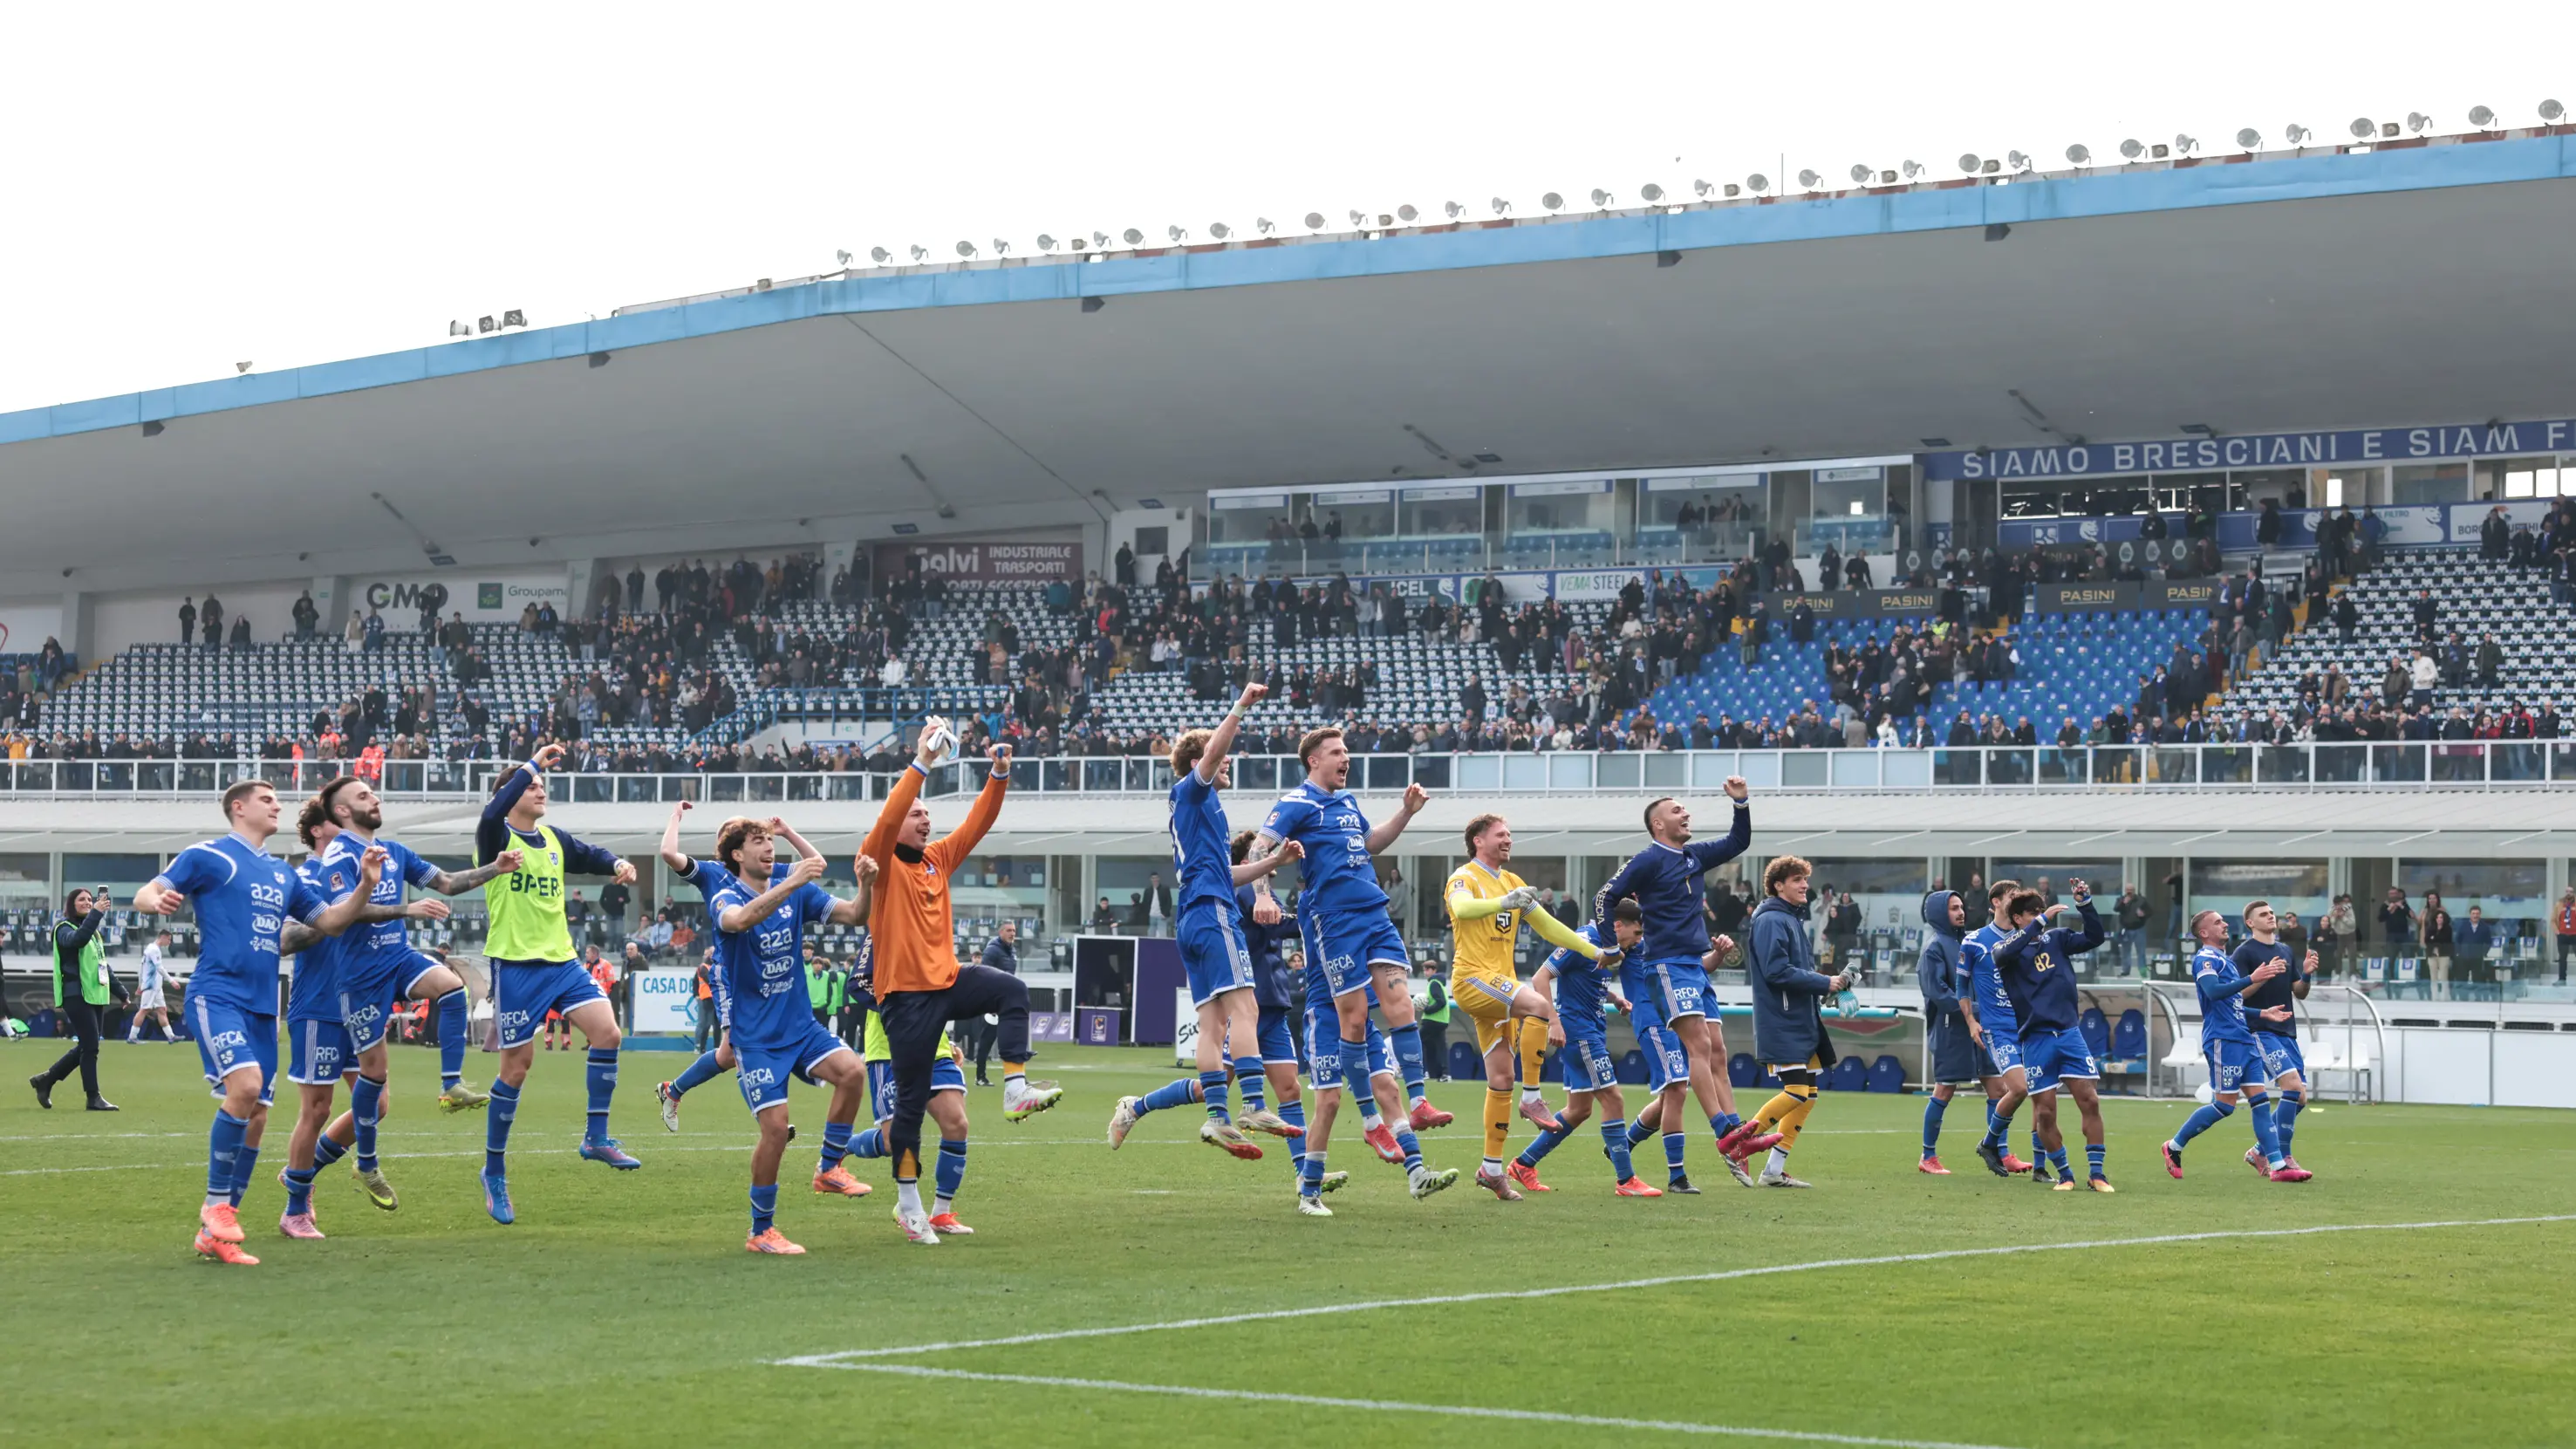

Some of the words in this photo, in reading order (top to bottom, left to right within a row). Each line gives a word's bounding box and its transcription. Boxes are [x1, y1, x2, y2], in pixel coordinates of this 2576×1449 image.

[1963, 447, 2089, 477] SIAMO
[2114, 434, 2337, 470] BRESCIANI
[2363, 432, 2383, 458] E
[2409, 425, 2519, 456] SIAM
[2547, 422, 2576, 449] F
[988, 546, 1072, 558] INDUSTRIALE
[994, 562, 1066, 574] TRASPORTI
[1881, 595, 1934, 607] PASINI
[2060, 590, 2115, 602] PASINI
[510, 871, 562, 897] BPER
[250, 883, 284, 906] a2a
[760, 927, 793, 949] a2a
[767, 960, 789, 974] DAC
[1326, 954, 1356, 974] RFCA
[2034, 952, 2056, 973] 82
[642, 977, 676, 994] CASA
[1673, 987, 1700, 1001] RFCA
[349, 1004, 381, 1026] RFCA
[500, 1009, 530, 1027] RFCA
[211, 1030, 247, 1049] RFCA
[316, 1047, 339, 1062] RFC
[1667, 1050, 1684, 1063] RFC
[1995, 1044, 2018, 1057] RFCA
[1594, 1056, 1613, 1070] RFC
[746, 1067, 775, 1088] RFCA
[882, 1081, 897, 1097] RF
